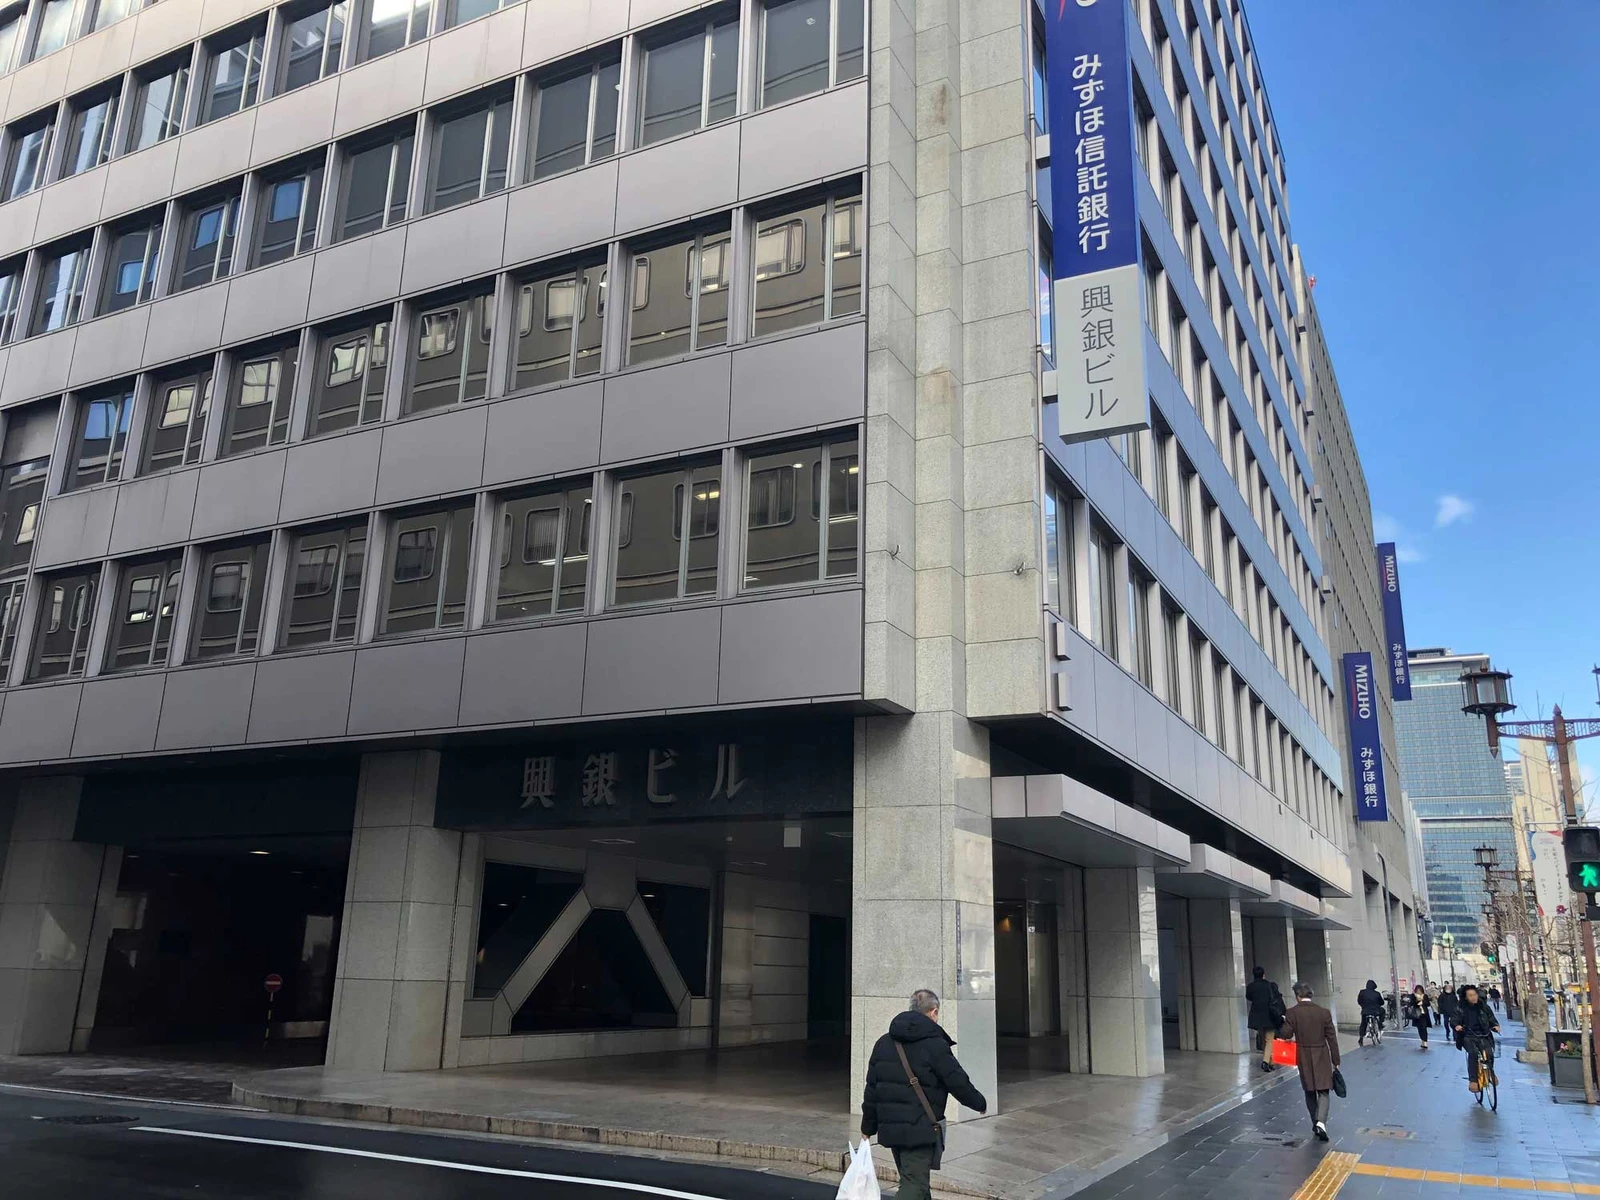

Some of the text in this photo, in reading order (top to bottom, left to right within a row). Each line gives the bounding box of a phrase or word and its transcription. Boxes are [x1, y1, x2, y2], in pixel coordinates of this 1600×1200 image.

[1072, 53, 1110, 254] みずほ信託銀行
[1081, 286, 1119, 420] 興銀ビル
[1384, 555, 1397, 593] MIZUHO
[1354, 664, 1371, 719] MIZUHO
[1392, 643, 1405, 685] みずほ銀行
[520, 743, 748, 809] 興銀ビル
[1360, 747, 1378, 807] みずほ銀行
